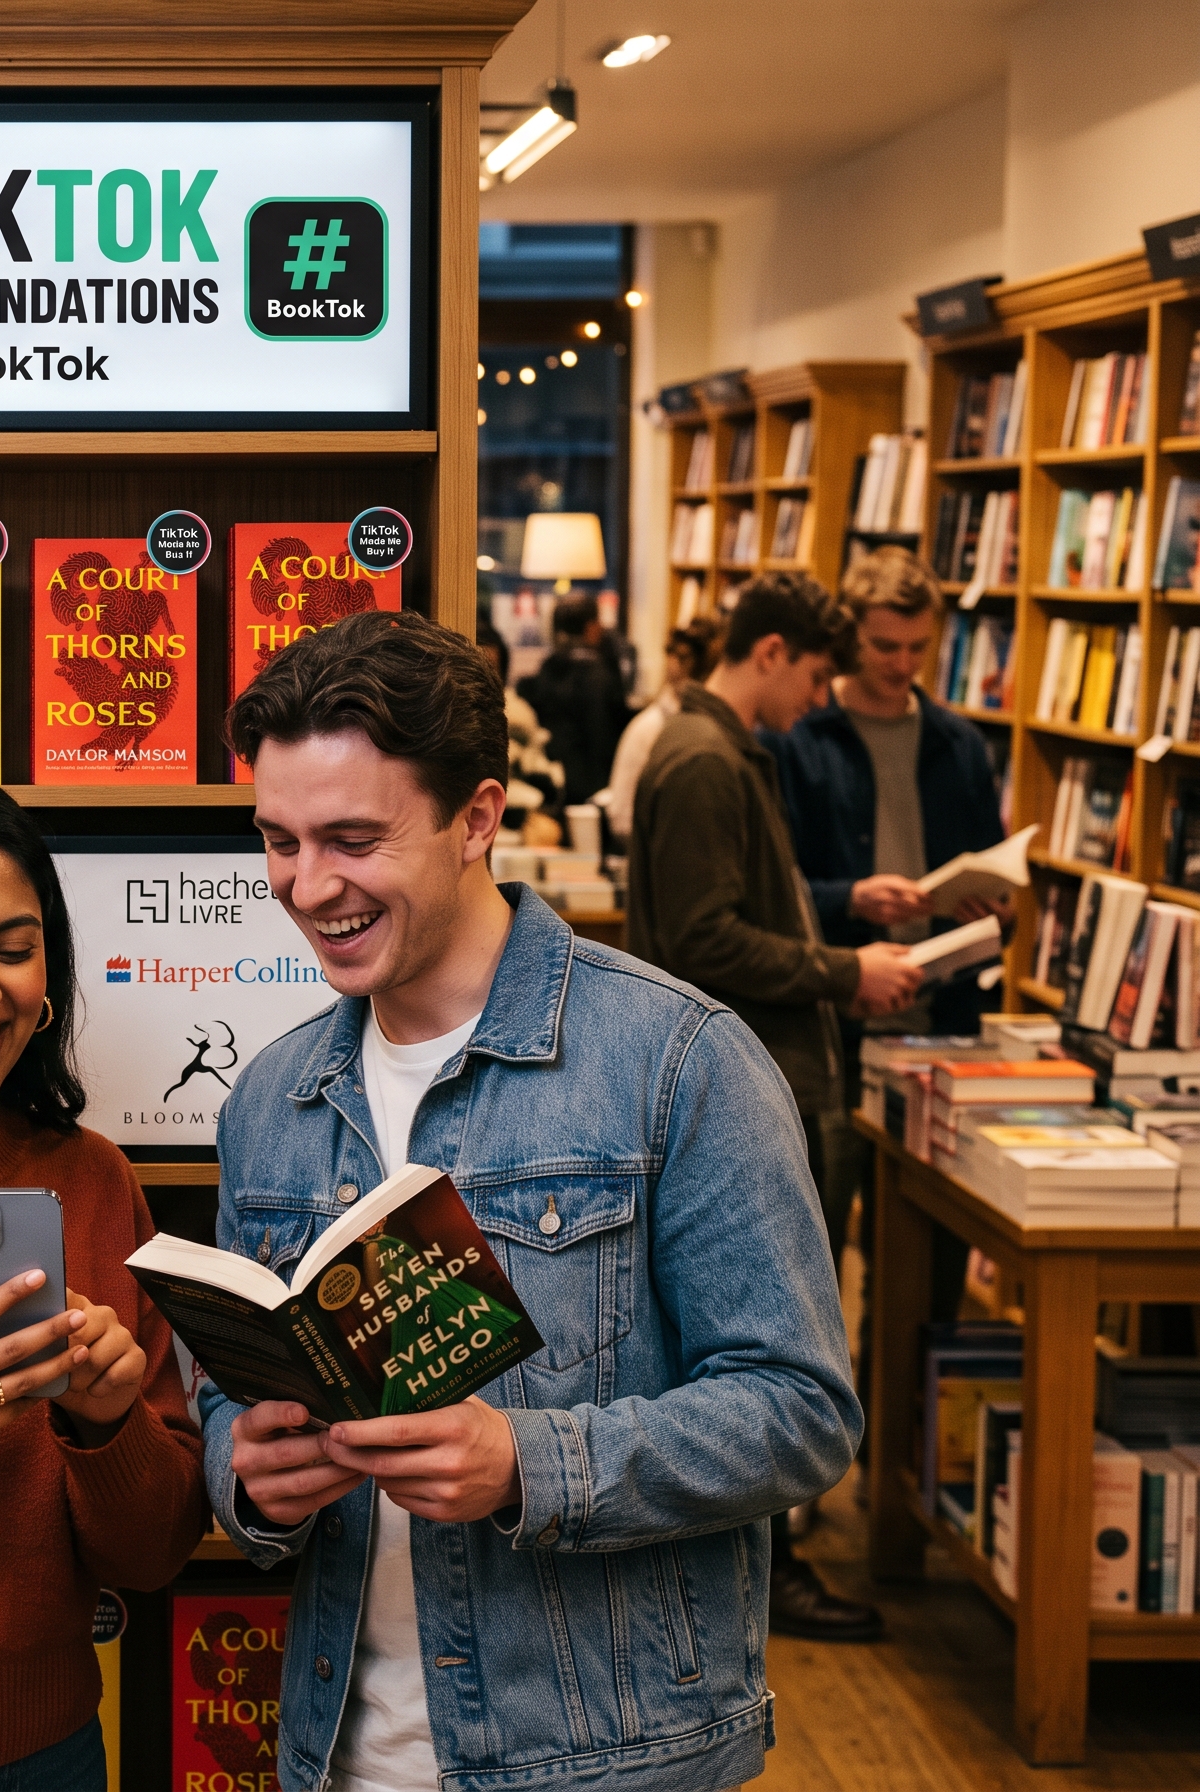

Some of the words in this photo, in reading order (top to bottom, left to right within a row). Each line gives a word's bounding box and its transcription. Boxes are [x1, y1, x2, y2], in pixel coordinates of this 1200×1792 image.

[267, 299, 366, 320] BookTok
[160, 528, 198, 538] TikTok
[361, 525, 399, 535] TikTok
[359, 537, 386, 545] Made
[367, 548, 385, 557] Buy
[246, 556, 270, 579] A
[46, 568, 67, 590] A
[277, 593, 310, 610] OF
[76, 604, 108, 621] OF
[45, 634, 186, 659] THORNS
[121, 671, 172, 689] AND
[47, 701, 157, 726] ROSES
[46, 749, 108, 761] DAYLOR
[114, 749, 186, 761] MAMSOM
[180, 905, 242, 924] LIVRE
[359, 1241, 445, 1311] SEVEN
[347, 1246, 481, 1350] HUSBANDS
[416, 1304, 430, 1326] of
[381, 1296, 491, 1379] EVELYN
[405, 1328, 492, 1395] HUGO
[185, 1628, 210, 1651] A
[218, 1668, 249, 1685] OF
